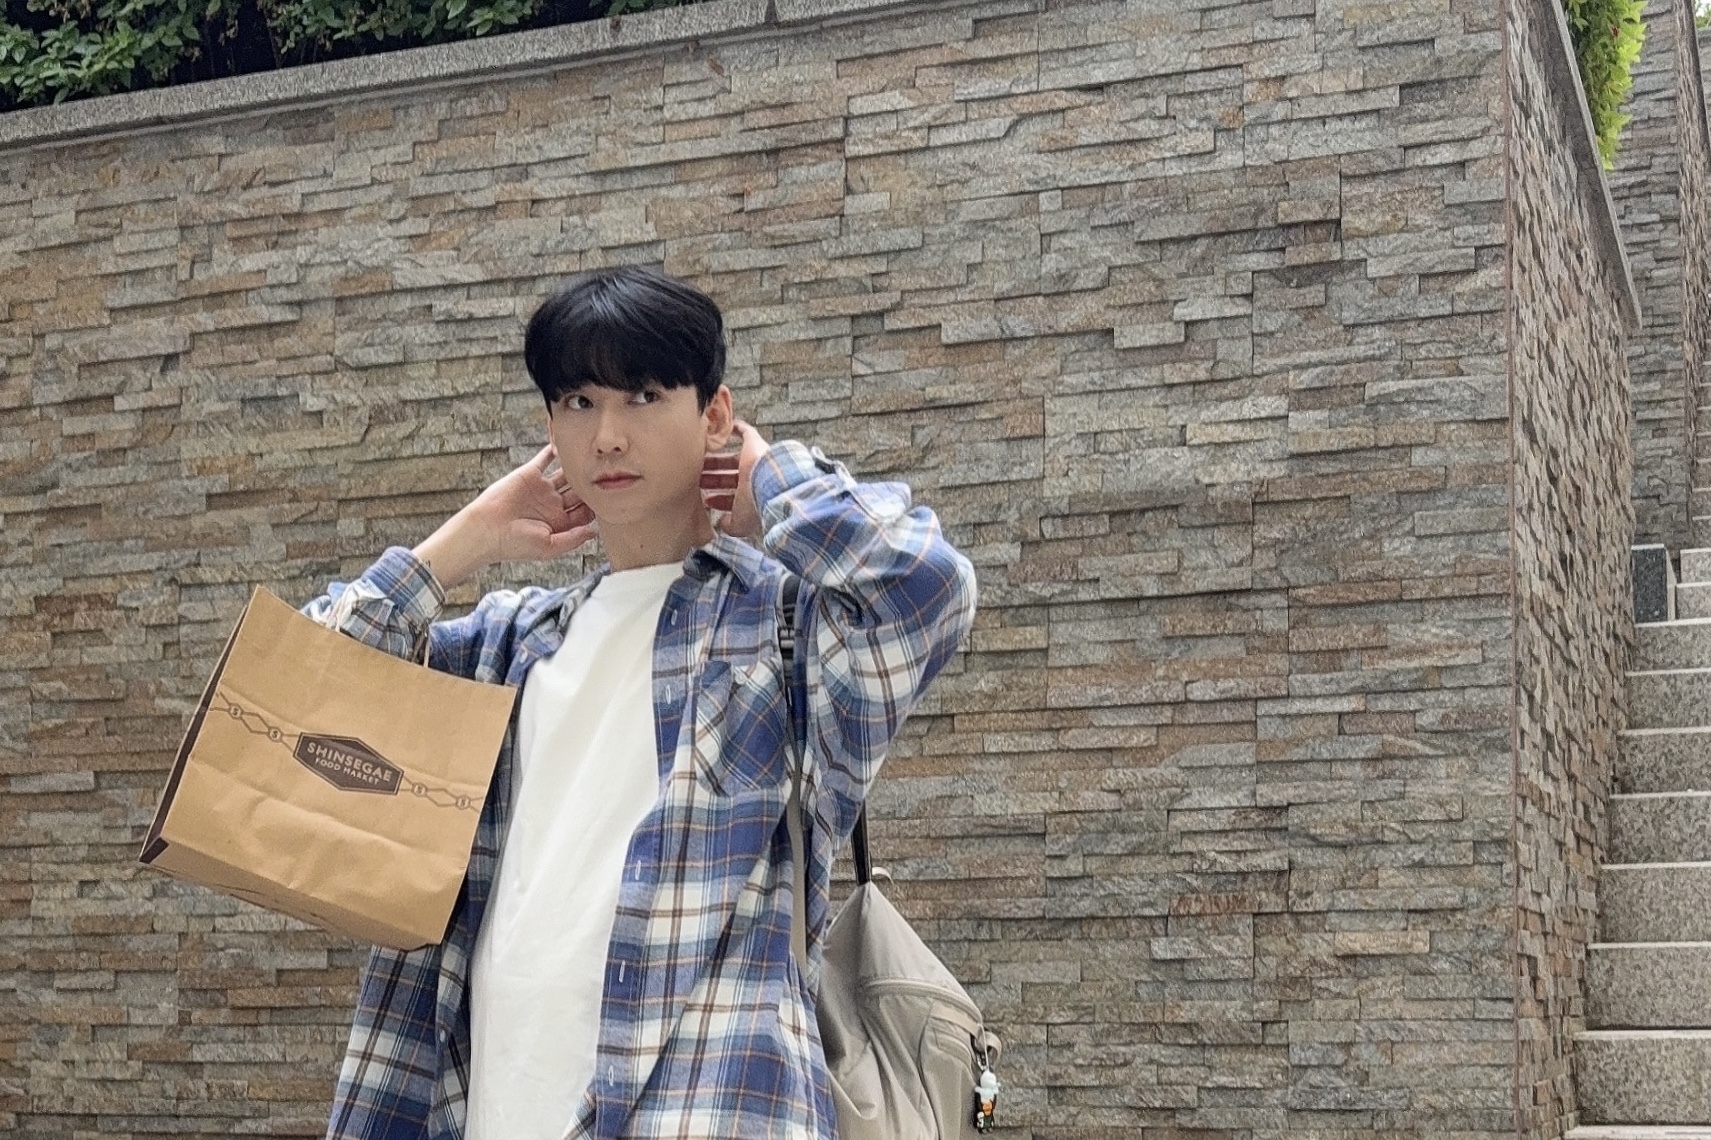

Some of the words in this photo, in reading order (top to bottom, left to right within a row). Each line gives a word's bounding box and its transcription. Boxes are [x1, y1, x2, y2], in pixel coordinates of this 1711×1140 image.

[307, 742, 393, 782] SHINSEGAE
[315, 757, 341, 771] FOOD
[343, 767, 380, 785] MARKET
